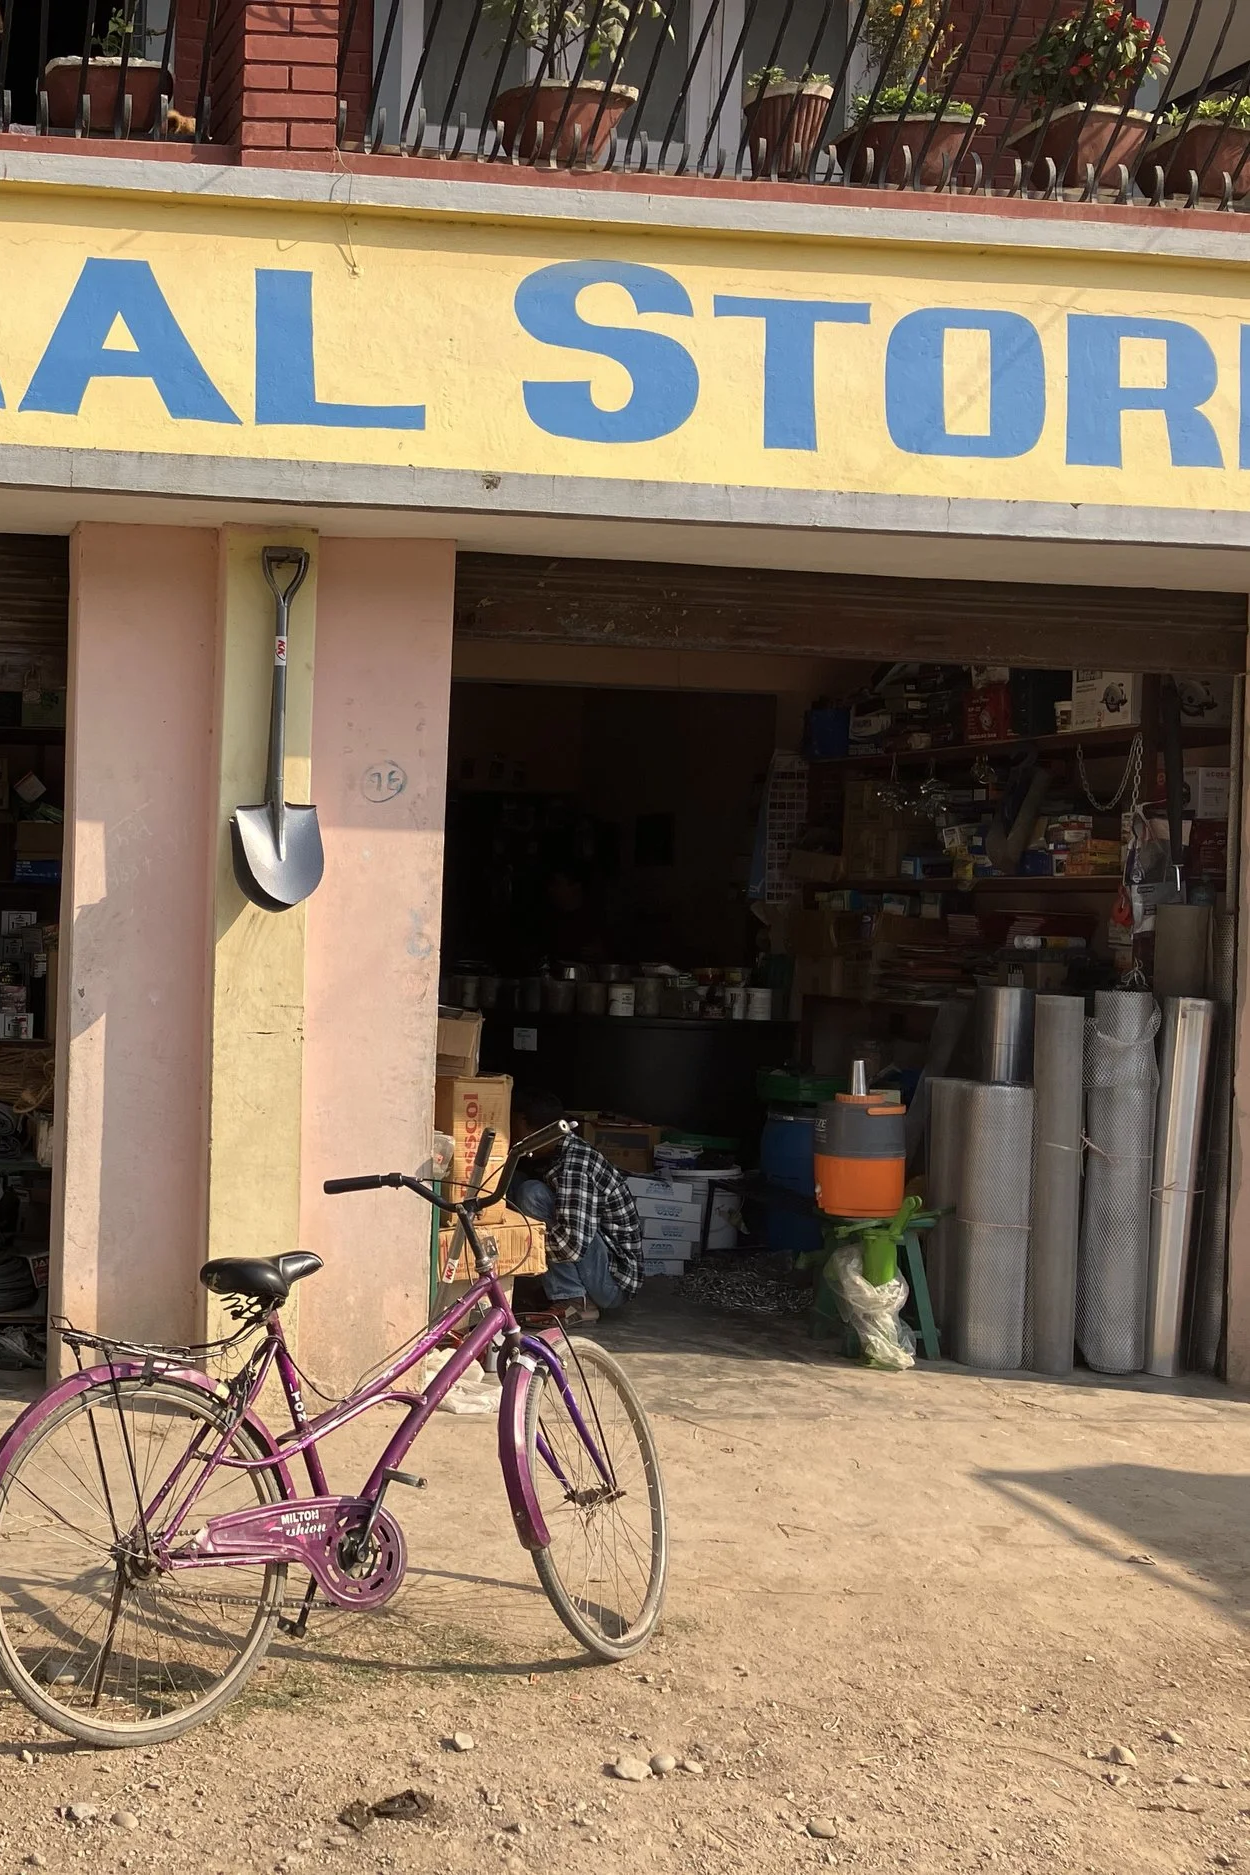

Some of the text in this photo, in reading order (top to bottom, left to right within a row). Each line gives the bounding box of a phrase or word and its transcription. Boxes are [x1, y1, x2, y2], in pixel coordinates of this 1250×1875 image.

[514, 259, 1250, 471] STOR
[444, 1265, 456, 1281] KK
[280, 1509, 320, 1525] MILTON
